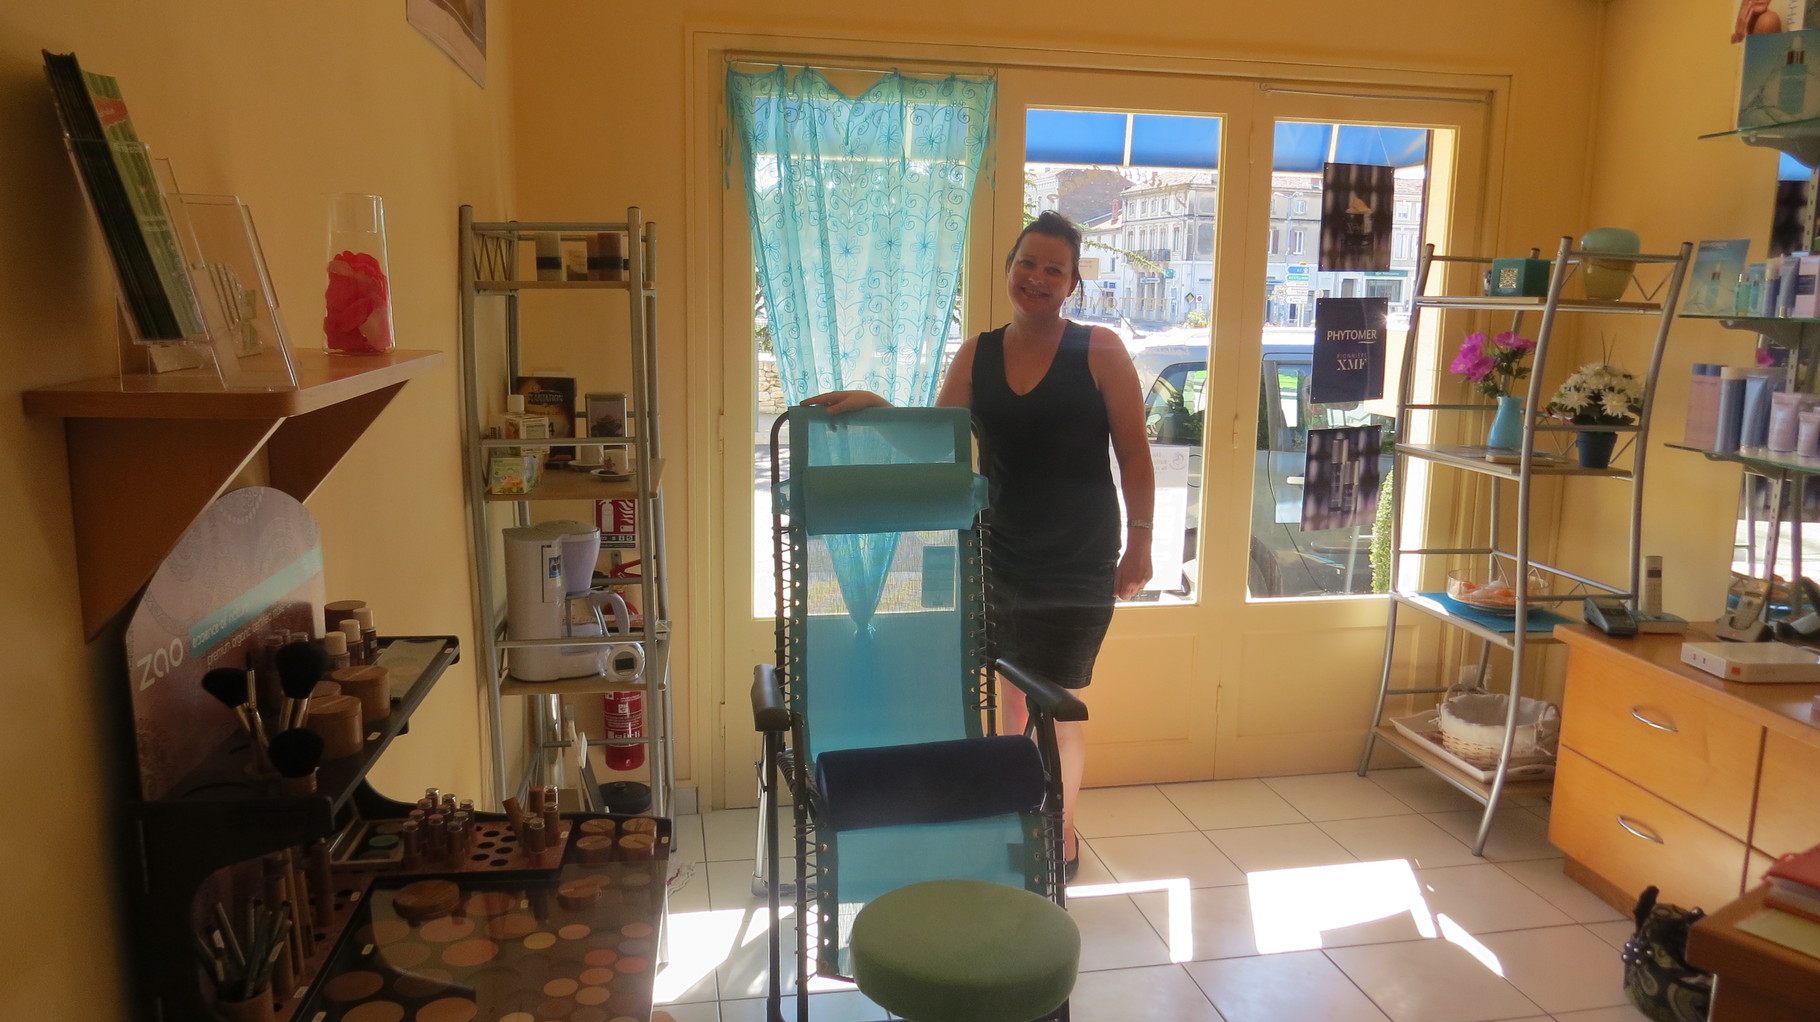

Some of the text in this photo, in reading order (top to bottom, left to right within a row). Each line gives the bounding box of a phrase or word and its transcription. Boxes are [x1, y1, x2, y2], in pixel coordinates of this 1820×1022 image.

[1326, 329, 1377, 341] PHYTOMER
[1336, 358, 1368, 371] XMF
[136, 637, 185, 692] zao
